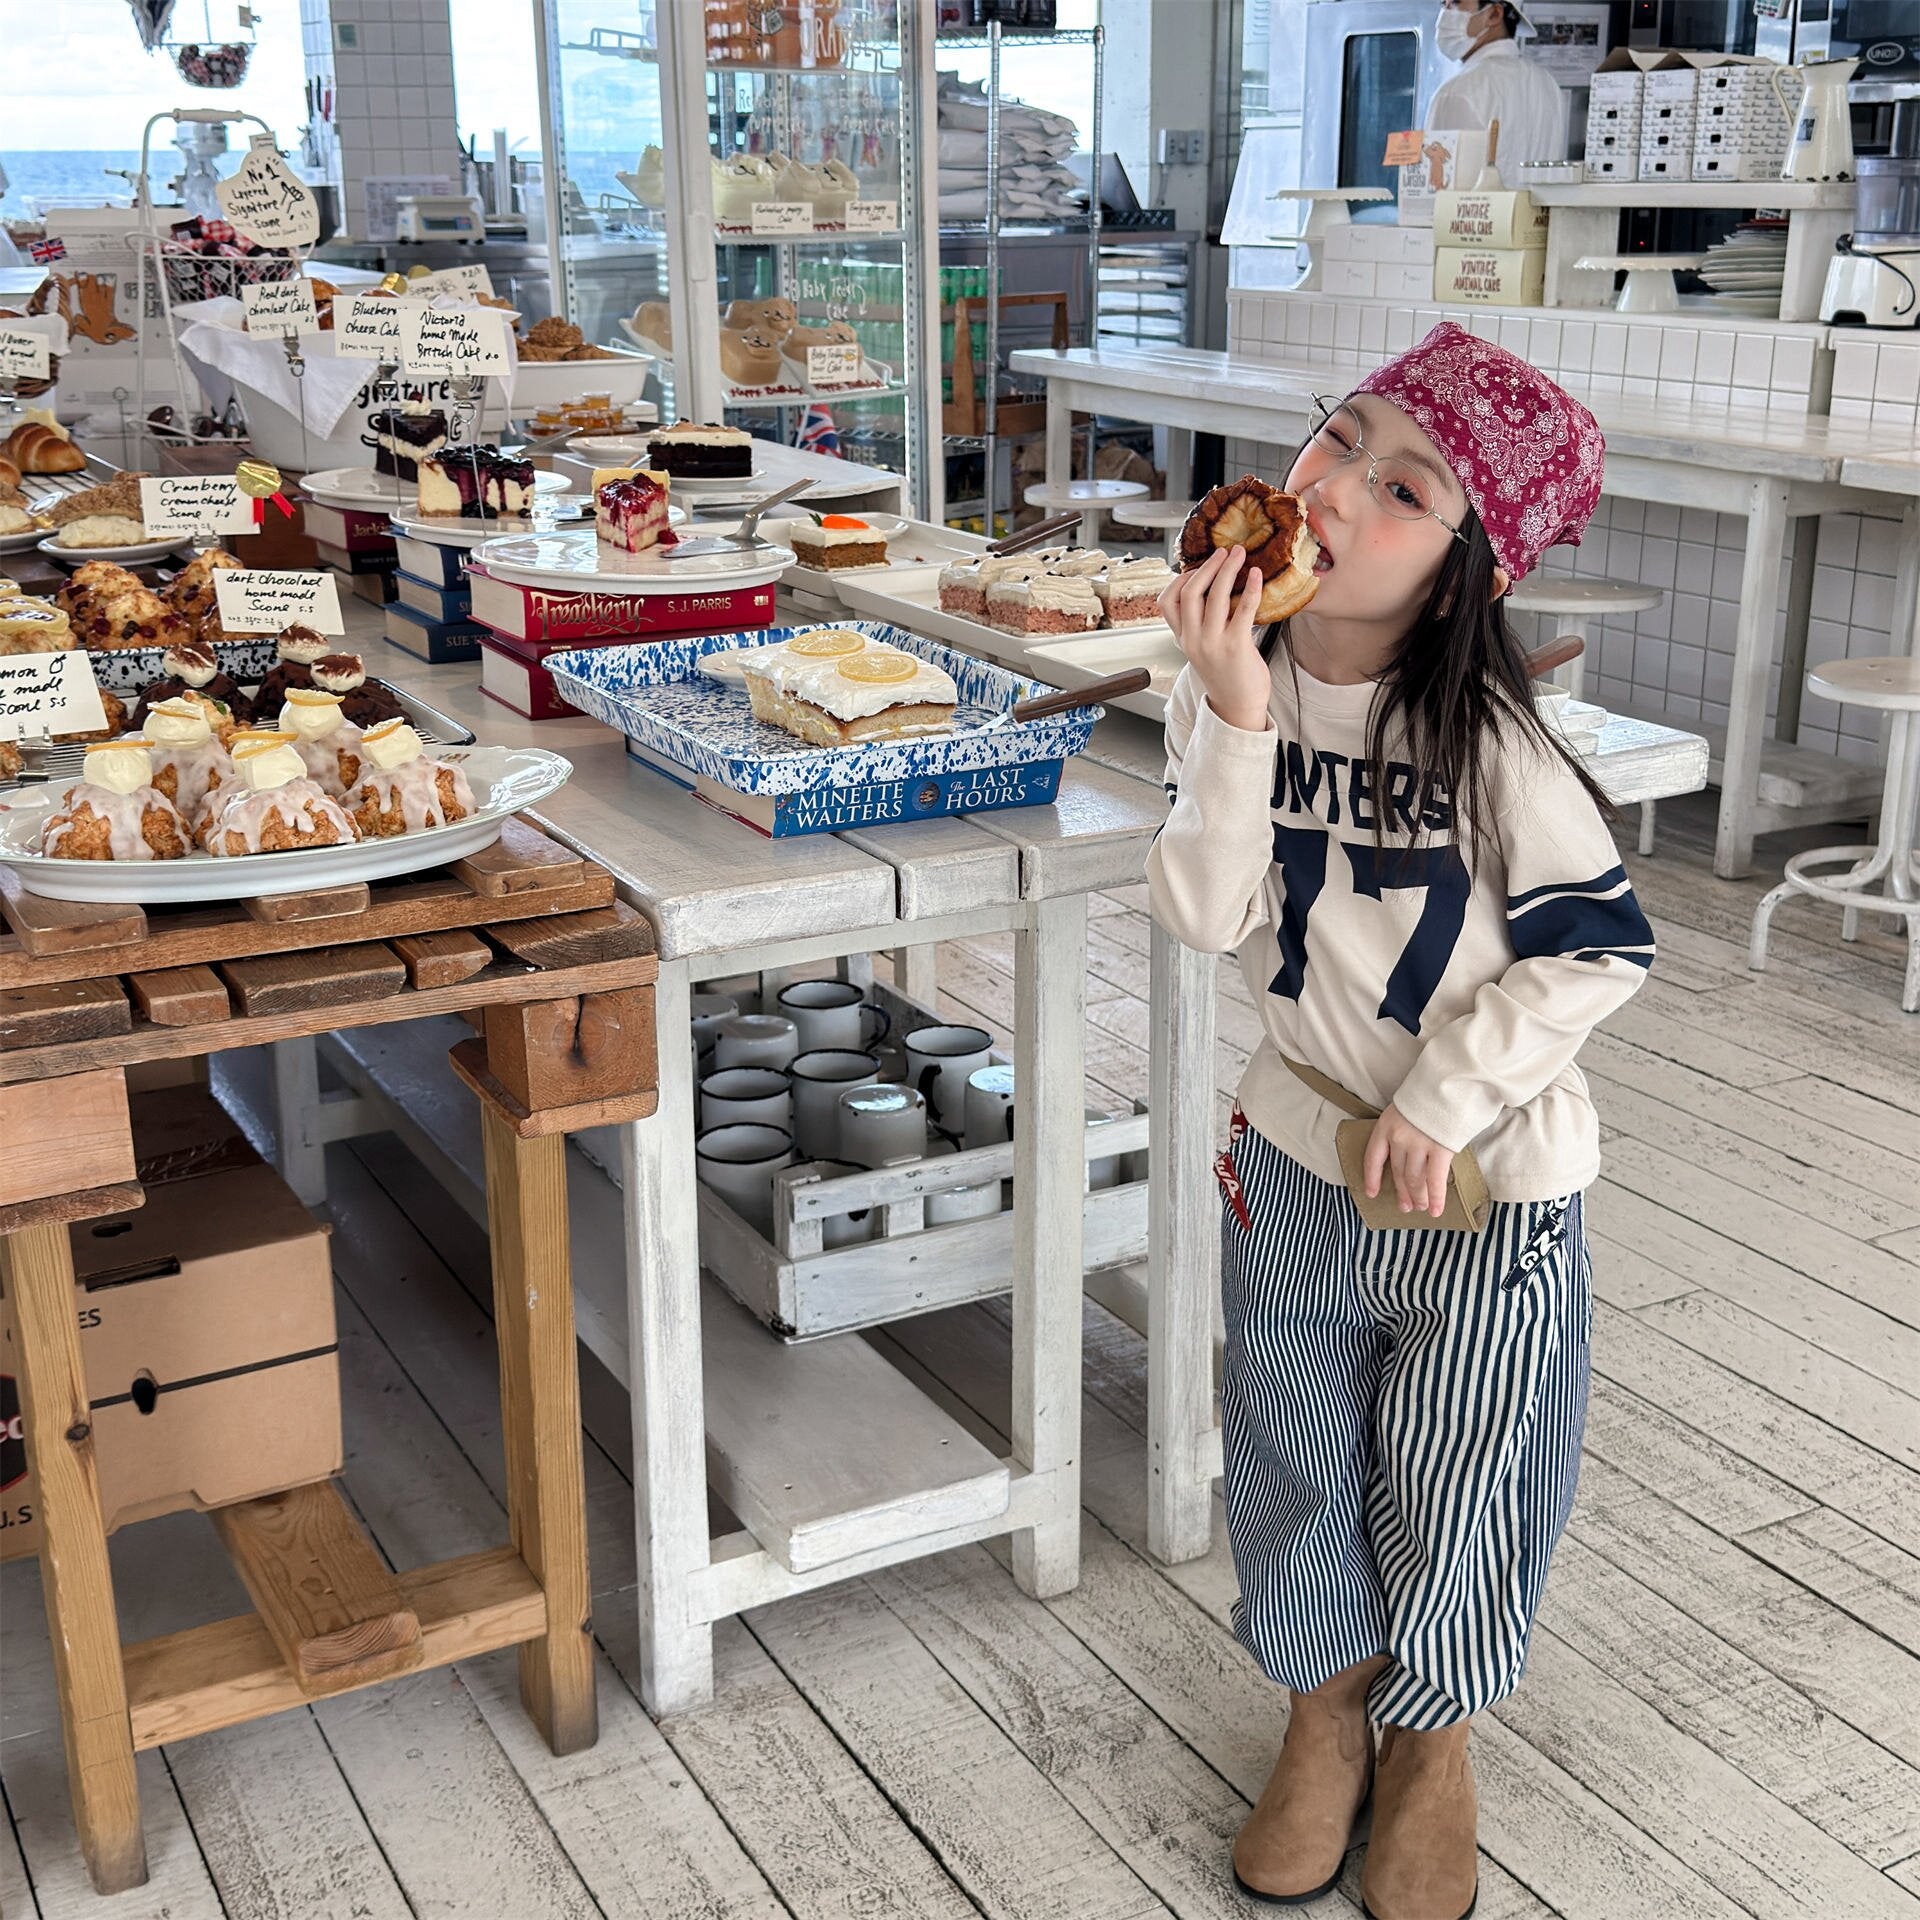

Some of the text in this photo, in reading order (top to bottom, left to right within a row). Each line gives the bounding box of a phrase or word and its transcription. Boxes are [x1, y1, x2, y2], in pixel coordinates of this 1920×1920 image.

[352, 301, 400, 317] Blueberr
[380, 321, 400, 337] Cak
[692, 597, 732, 610] PARRIS
[531, 592, 654, 639] Treachery
[446, 636, 470, 648] SUE
[0, 668, 38, 679] mon
[950, 781, 965, 792] The
[970, 769, 1024, 790] LAST
[1270, 739, 1452, 833] UNTERS
[797, 782, 904, 811] MINETTE
[945, 784, 1026, 811] HOURS
[796, 801, 903, 829] WALTERS
